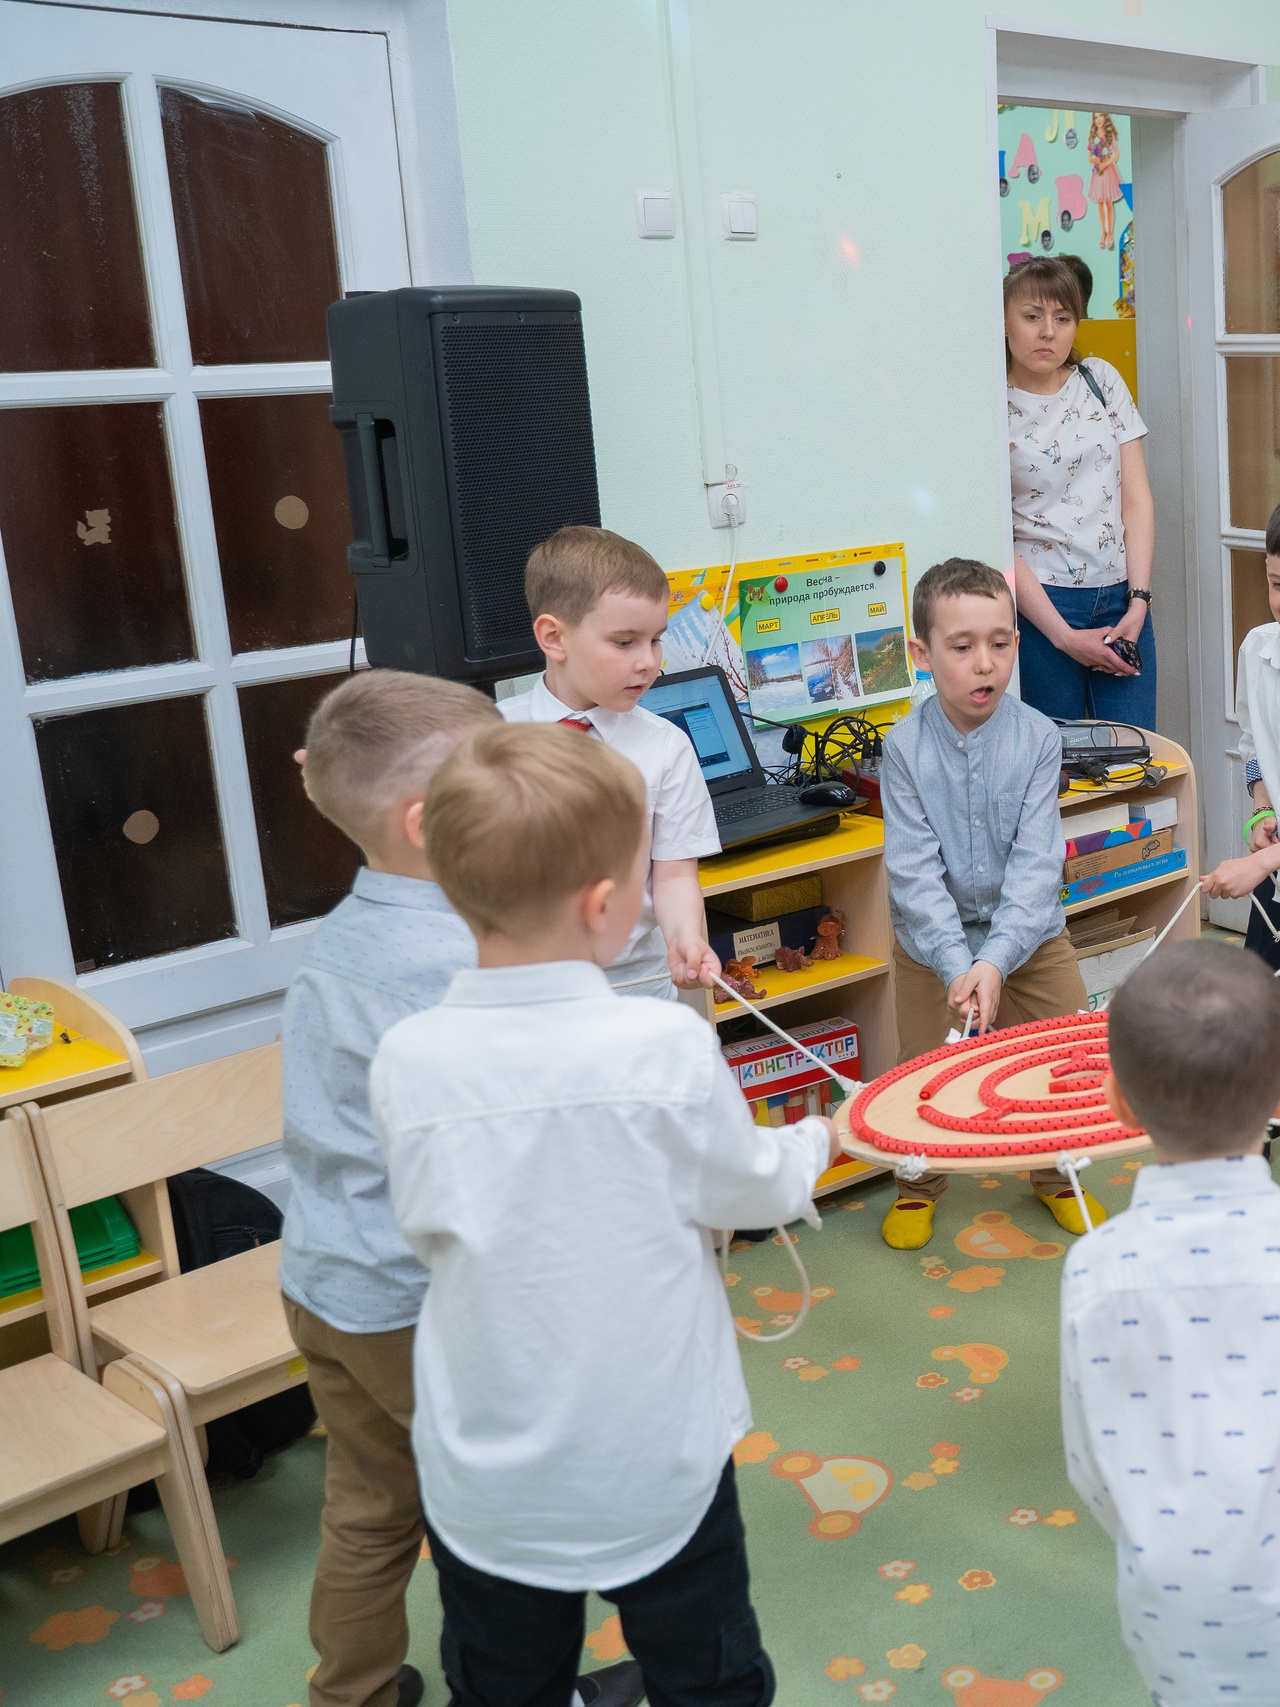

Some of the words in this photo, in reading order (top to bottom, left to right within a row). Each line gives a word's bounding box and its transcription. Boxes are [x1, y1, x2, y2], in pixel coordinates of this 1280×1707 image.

[806, 575, 833, 587] Весна
[769, 593, 811, 607] природа
[869, 604, 885, 614] МАЙ
[812, 612, 838, 623] АПРЕЛЬ
[758, 621, 779, 631] МАРТ
[738, 929, 775, 944] МАТЕМАТИКА
